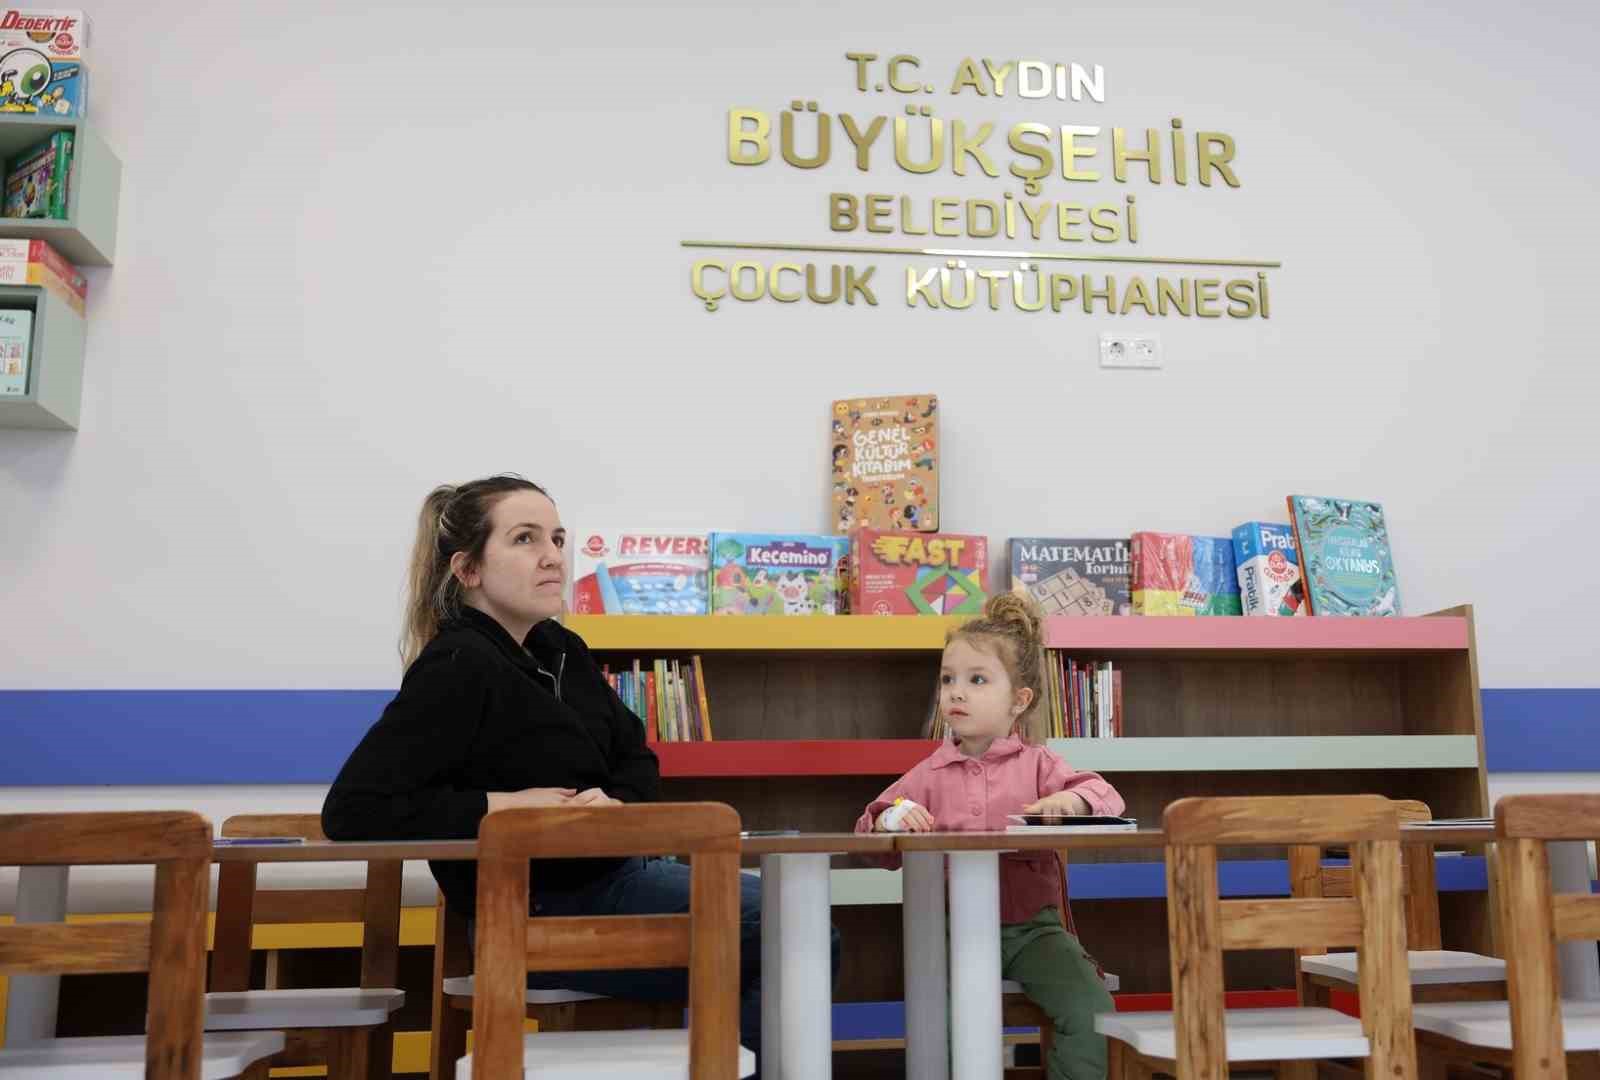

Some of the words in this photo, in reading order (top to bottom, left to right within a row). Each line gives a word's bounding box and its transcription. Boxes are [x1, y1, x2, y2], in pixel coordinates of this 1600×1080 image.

[846, 52, 935, 94] T.C.
[950, 57, 1106, 103] AYDIN
[727, 100, 1241, 195] BÜYÜKŞEHİR
[829, 191, 1138, 244] BELEDİYESİ
[690, 261, 878, 313] ÇOCUK
[905, 258, 1271, 319] KÜTÜPHANESİ
[871, 536, 965, 567] FAST
